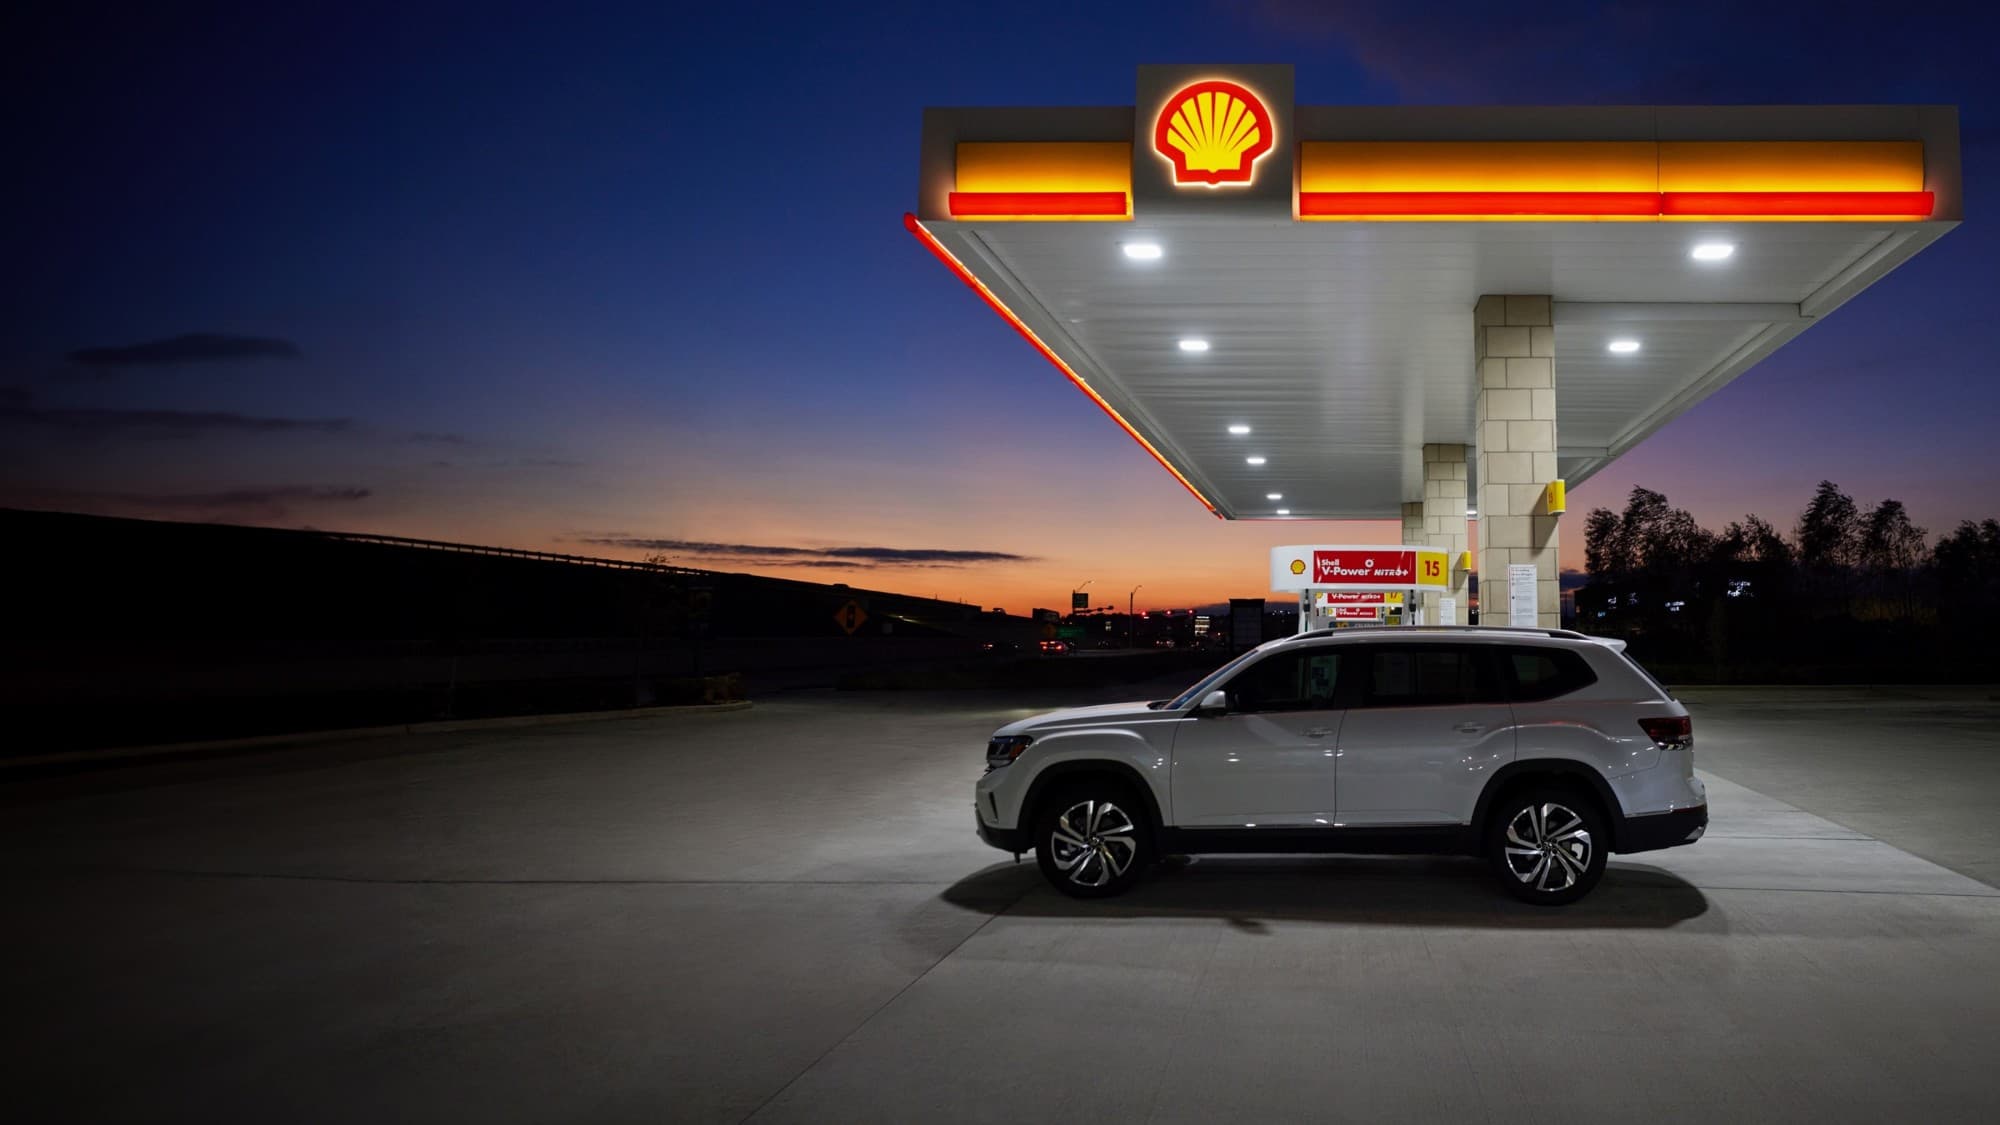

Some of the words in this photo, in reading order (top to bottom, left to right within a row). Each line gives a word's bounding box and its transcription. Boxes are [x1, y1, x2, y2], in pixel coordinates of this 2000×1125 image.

[1321, 566, 1370, 576] V-Power
[1374, 568, 1408, 576] NITRO+
[1424, 560, 1440, 577] 15
